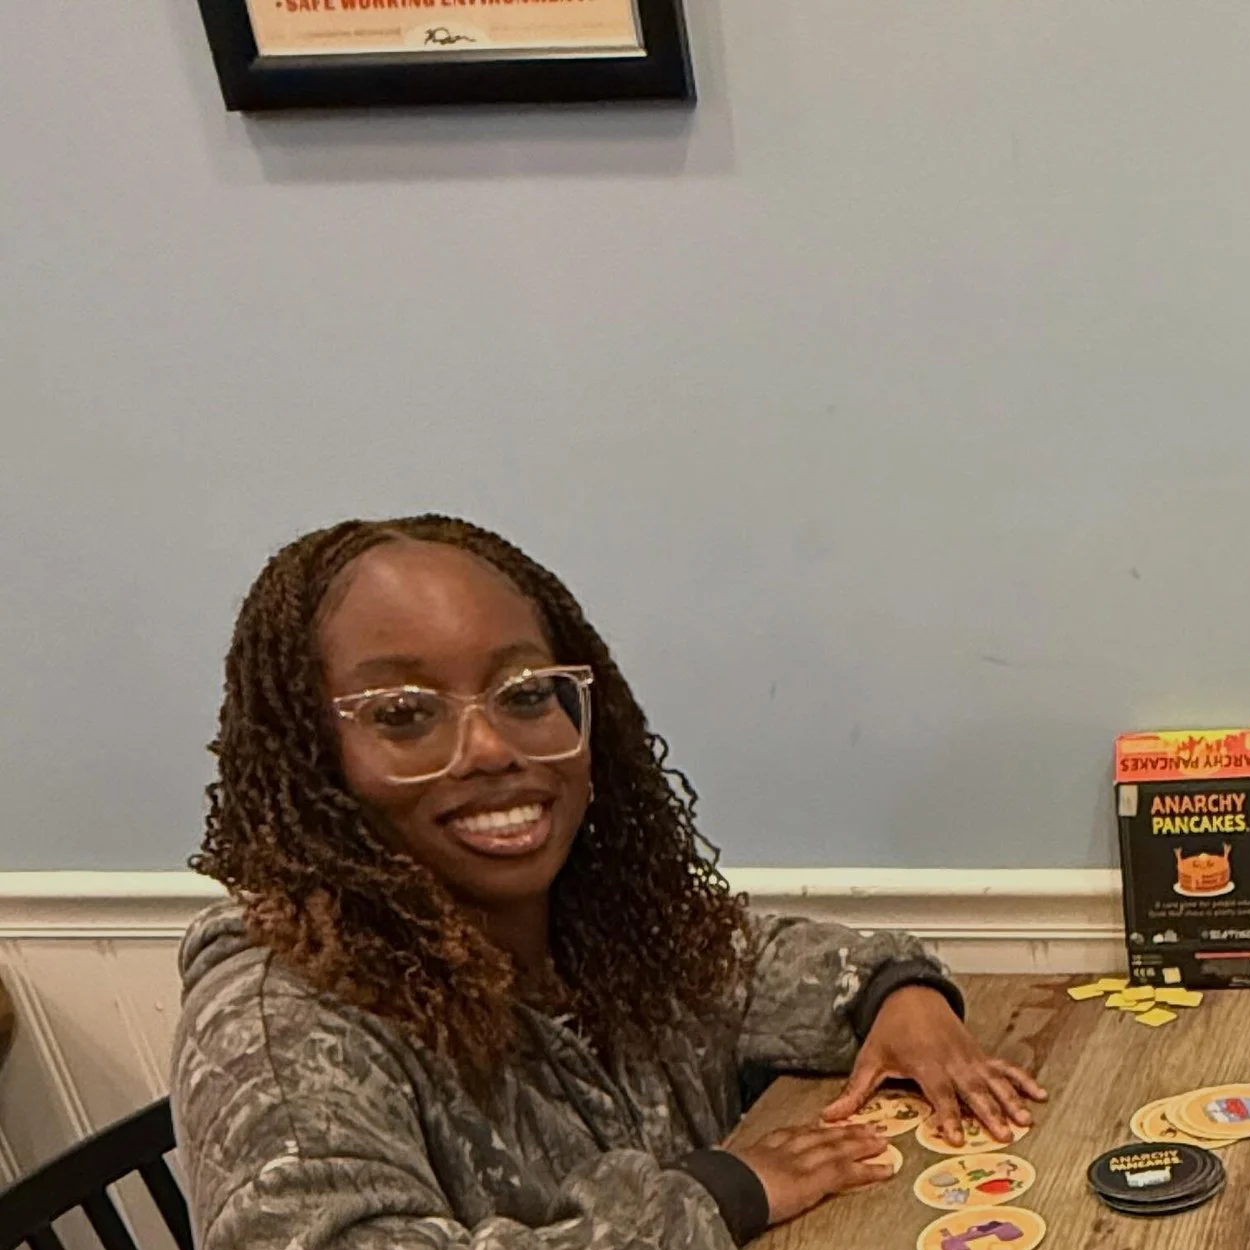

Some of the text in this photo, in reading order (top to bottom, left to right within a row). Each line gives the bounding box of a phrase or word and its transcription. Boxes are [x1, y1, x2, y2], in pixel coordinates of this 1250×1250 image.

[1120, 754, 1199, 772] PANCAKES
[1151, 792, 1247, 815] ANARCHY
[1152, 814, 1248, 834] PANCAKES
